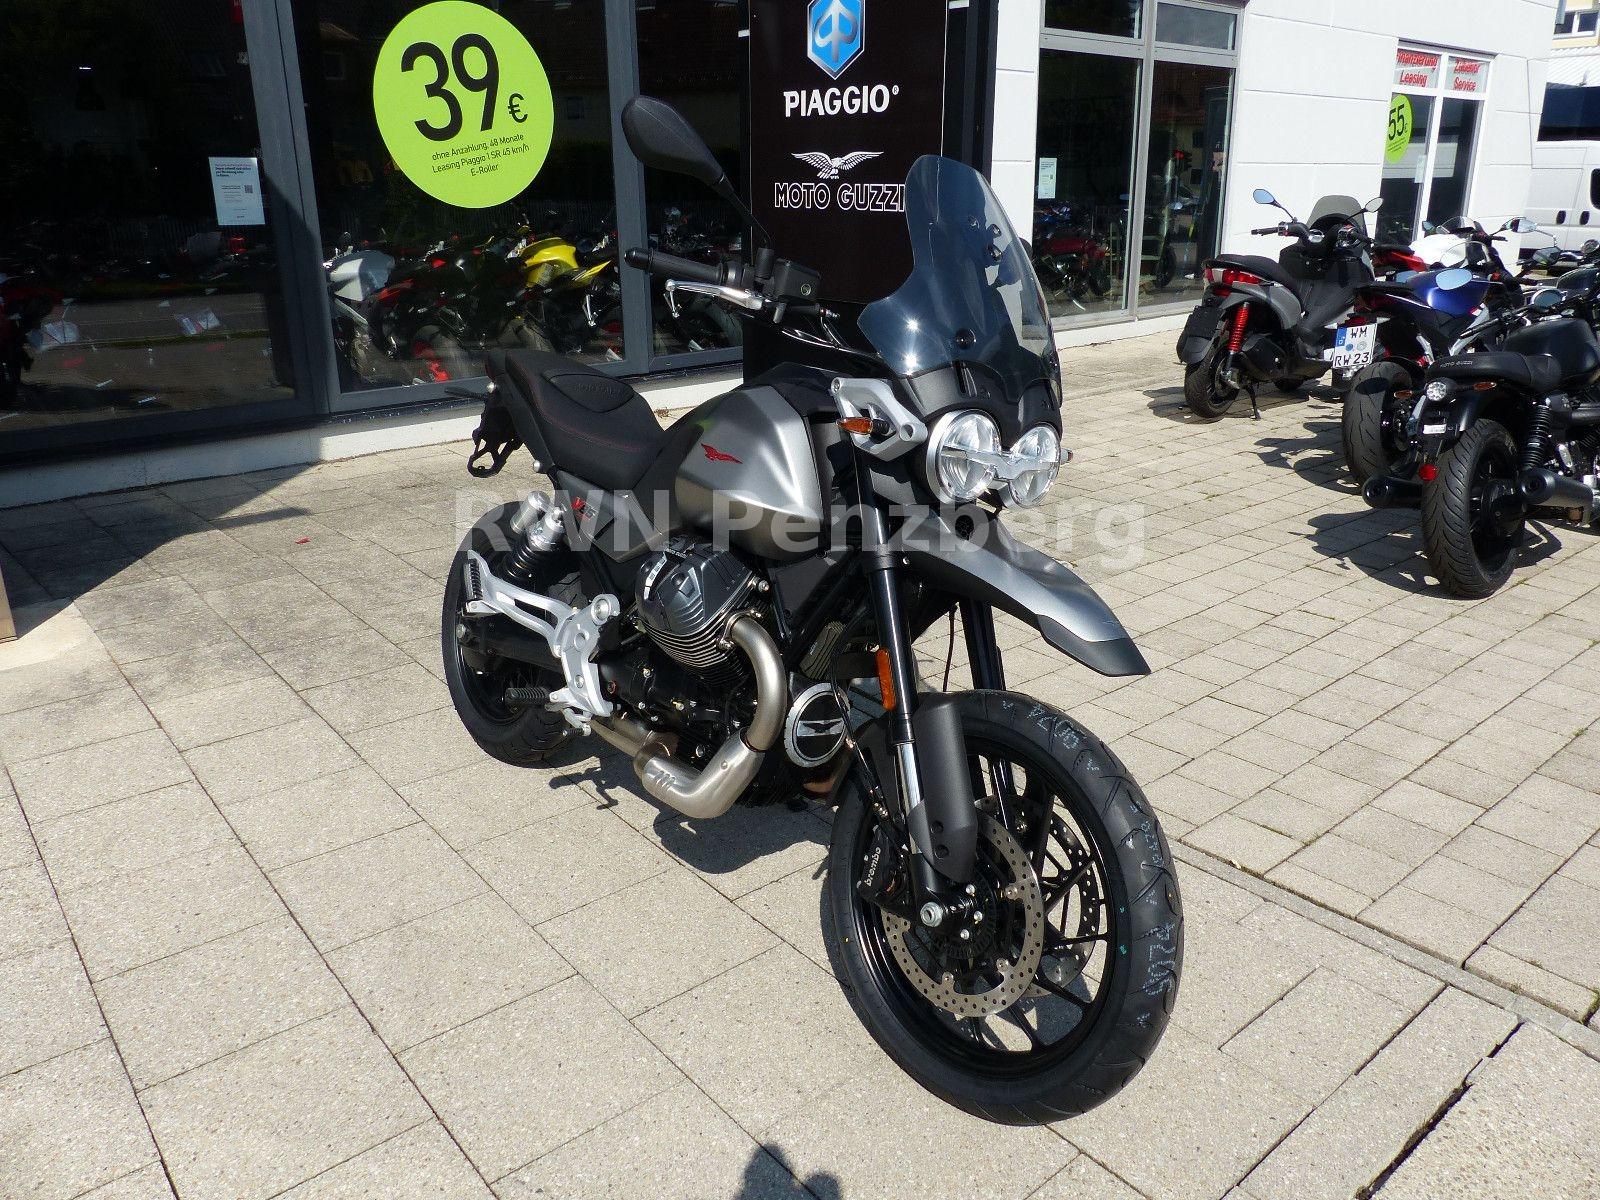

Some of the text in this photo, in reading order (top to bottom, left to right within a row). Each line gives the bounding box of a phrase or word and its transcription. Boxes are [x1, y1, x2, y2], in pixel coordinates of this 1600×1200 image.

[400, 33, 528, 142] 39 €
[1399, 69, 1428, 88] Leasing
[1453, 76, 1477, 92] Service
[1388, 103, 1405, 141] 55
[431, 151, 450, 161] ohne
[489, 138, 499, 147] 48
[499, 133, 524, 145] Monate
[431, 160, 461, 174] Leasing
[460, 154, 486, 167] Piaggio
[502, 147, 511, 157] 45
[511, 142, 530, 155] km/h
[470, 163, 499, 177] E-Roller
[774, 182, 831, 209] MOTO
[1350, 326, 1368, 339] WM
[1334, 351, 1370, 367] RW 23
[863, 846, 882, 887] brembo
